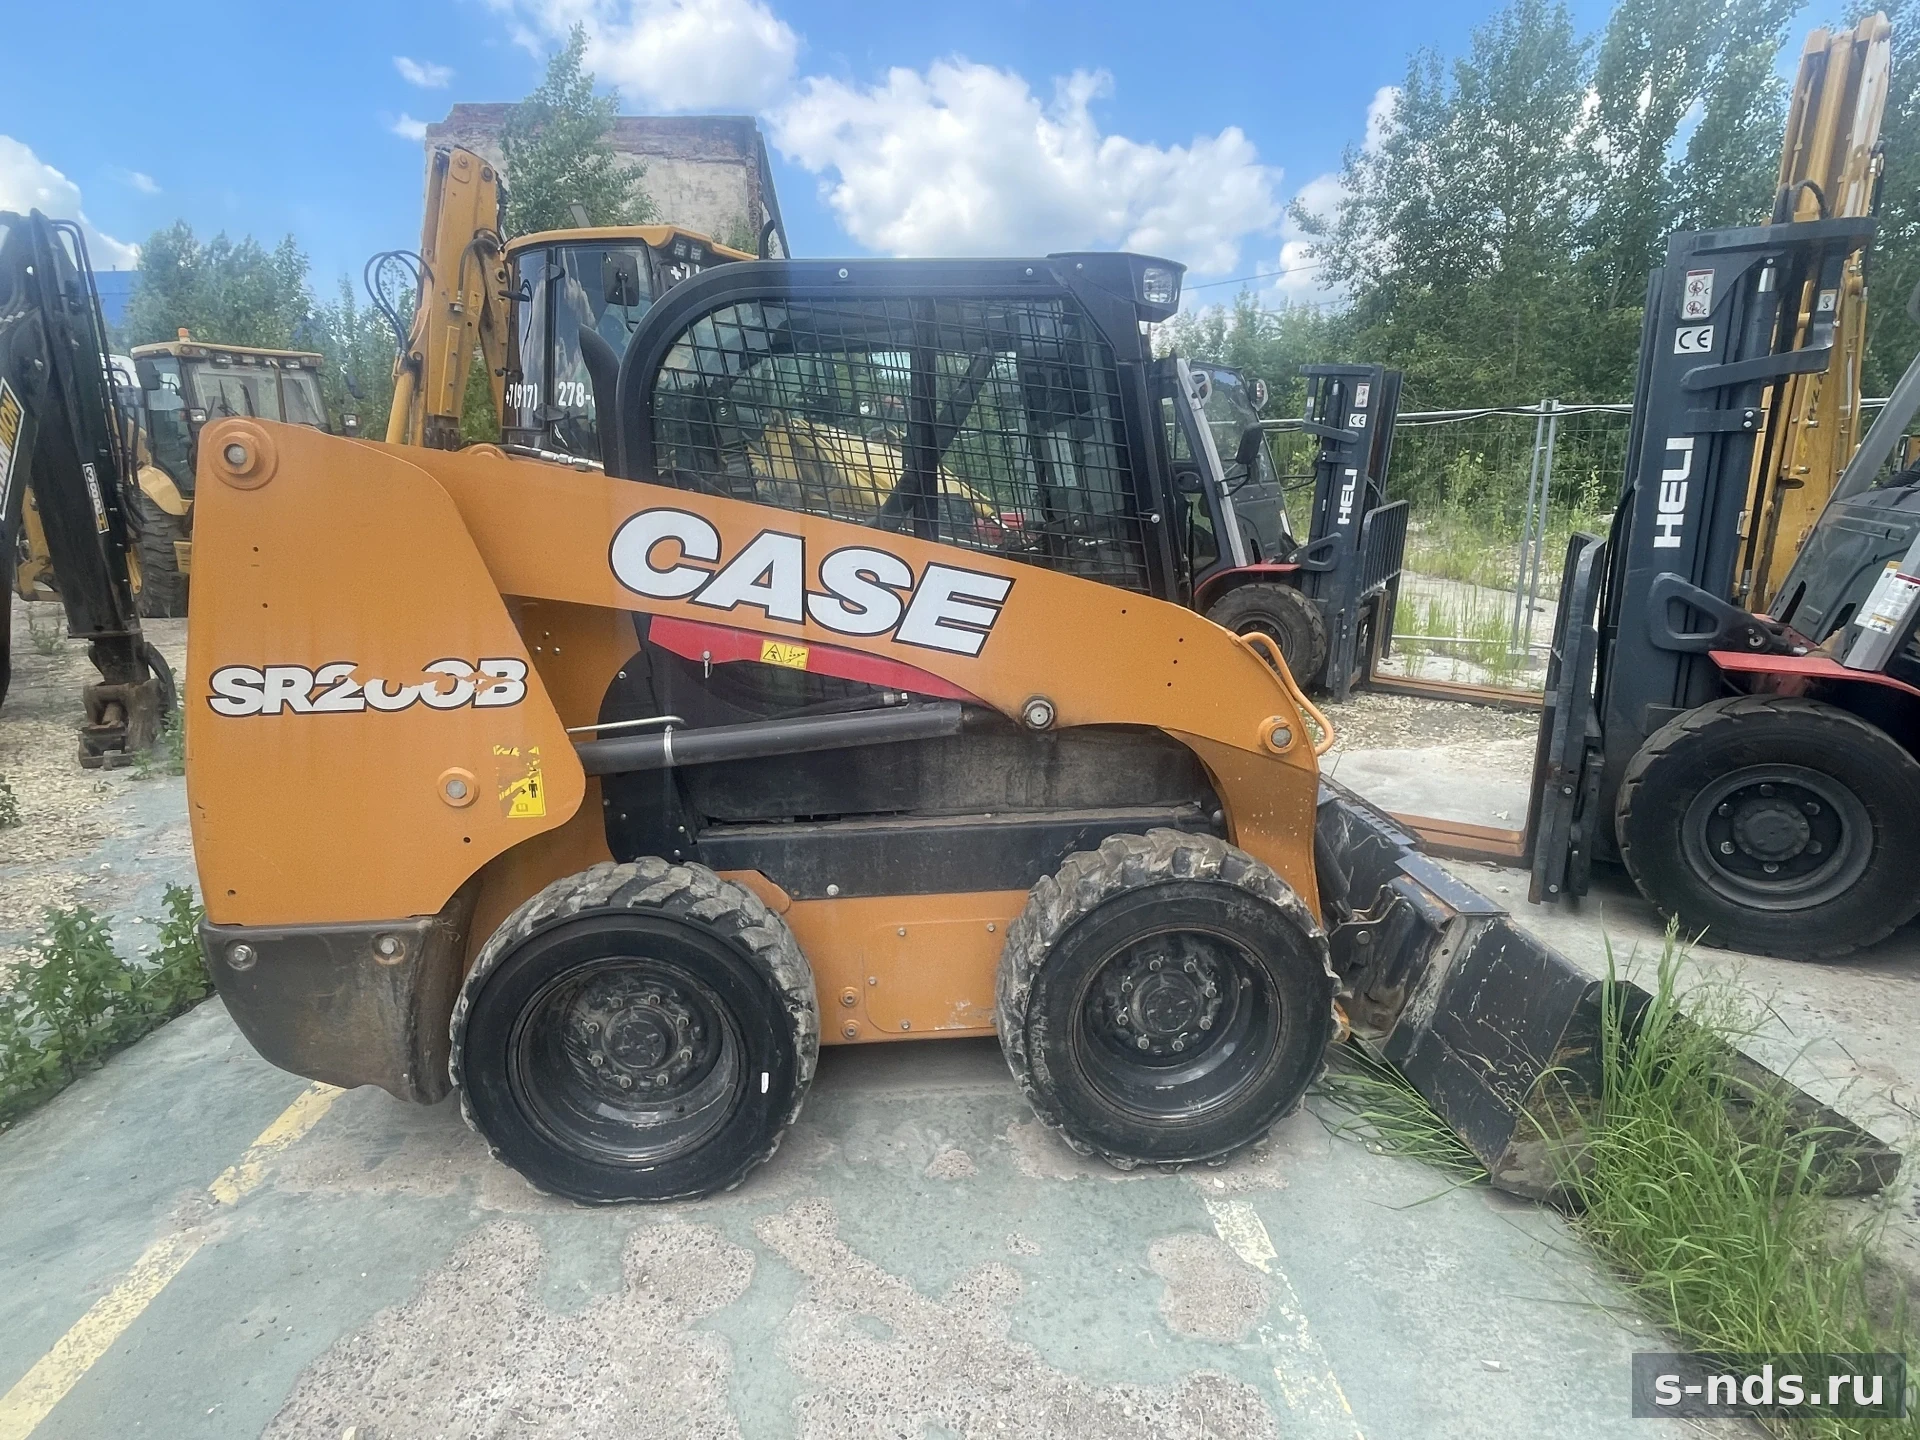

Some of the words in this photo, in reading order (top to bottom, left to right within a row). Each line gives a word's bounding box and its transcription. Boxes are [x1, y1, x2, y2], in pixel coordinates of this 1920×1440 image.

[1678, 329, 1711, 350] CE
[506, 382, 538, 411] +7(917)
[1337, 468, 1358, 525] HELI
[1653, 437, 1695, 548] HELI
[608, 507, 1016, 658] CASE
[206, 657, 529, 718] SR200B
